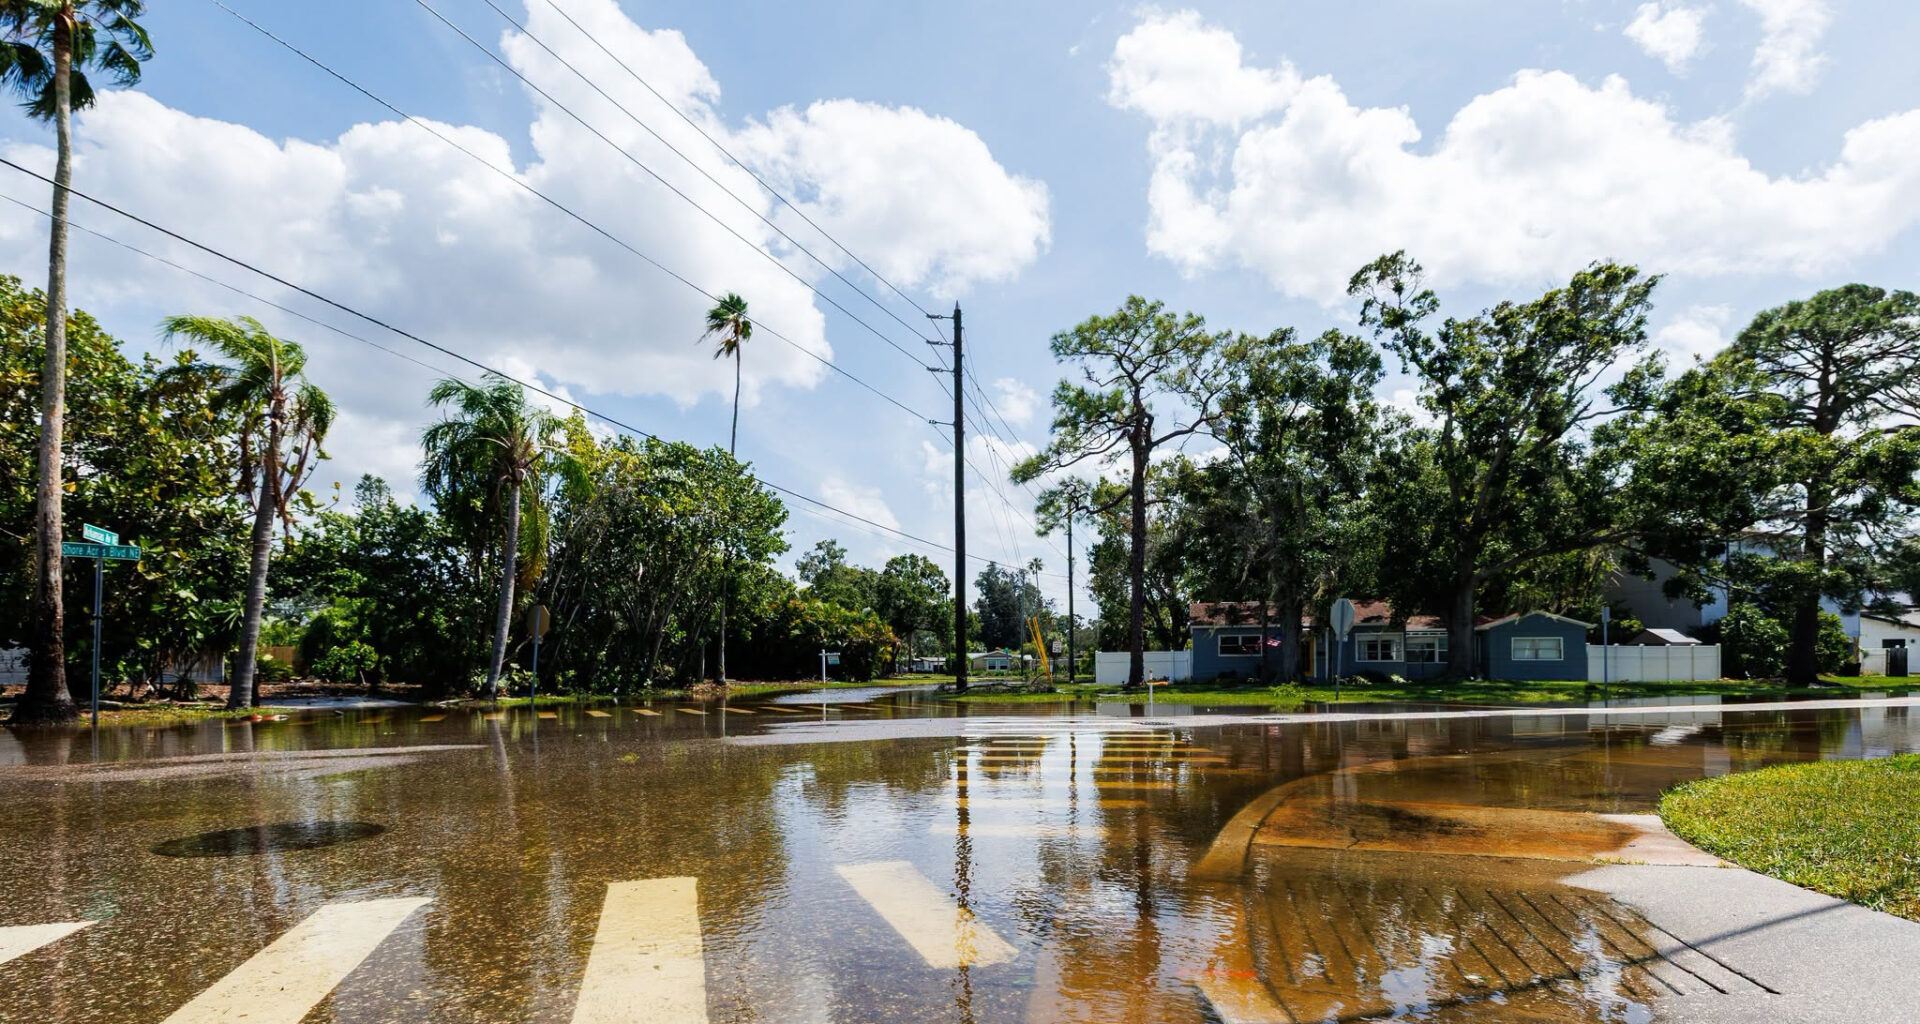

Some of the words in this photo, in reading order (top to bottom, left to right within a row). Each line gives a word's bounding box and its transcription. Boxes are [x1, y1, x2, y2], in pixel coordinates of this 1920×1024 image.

[62, 544, 84, 555] Shore
[86, 545, 106, 556] Acrs
[109, 546, 127, 558] Blvd
[129, 548, 139, 559] NE
